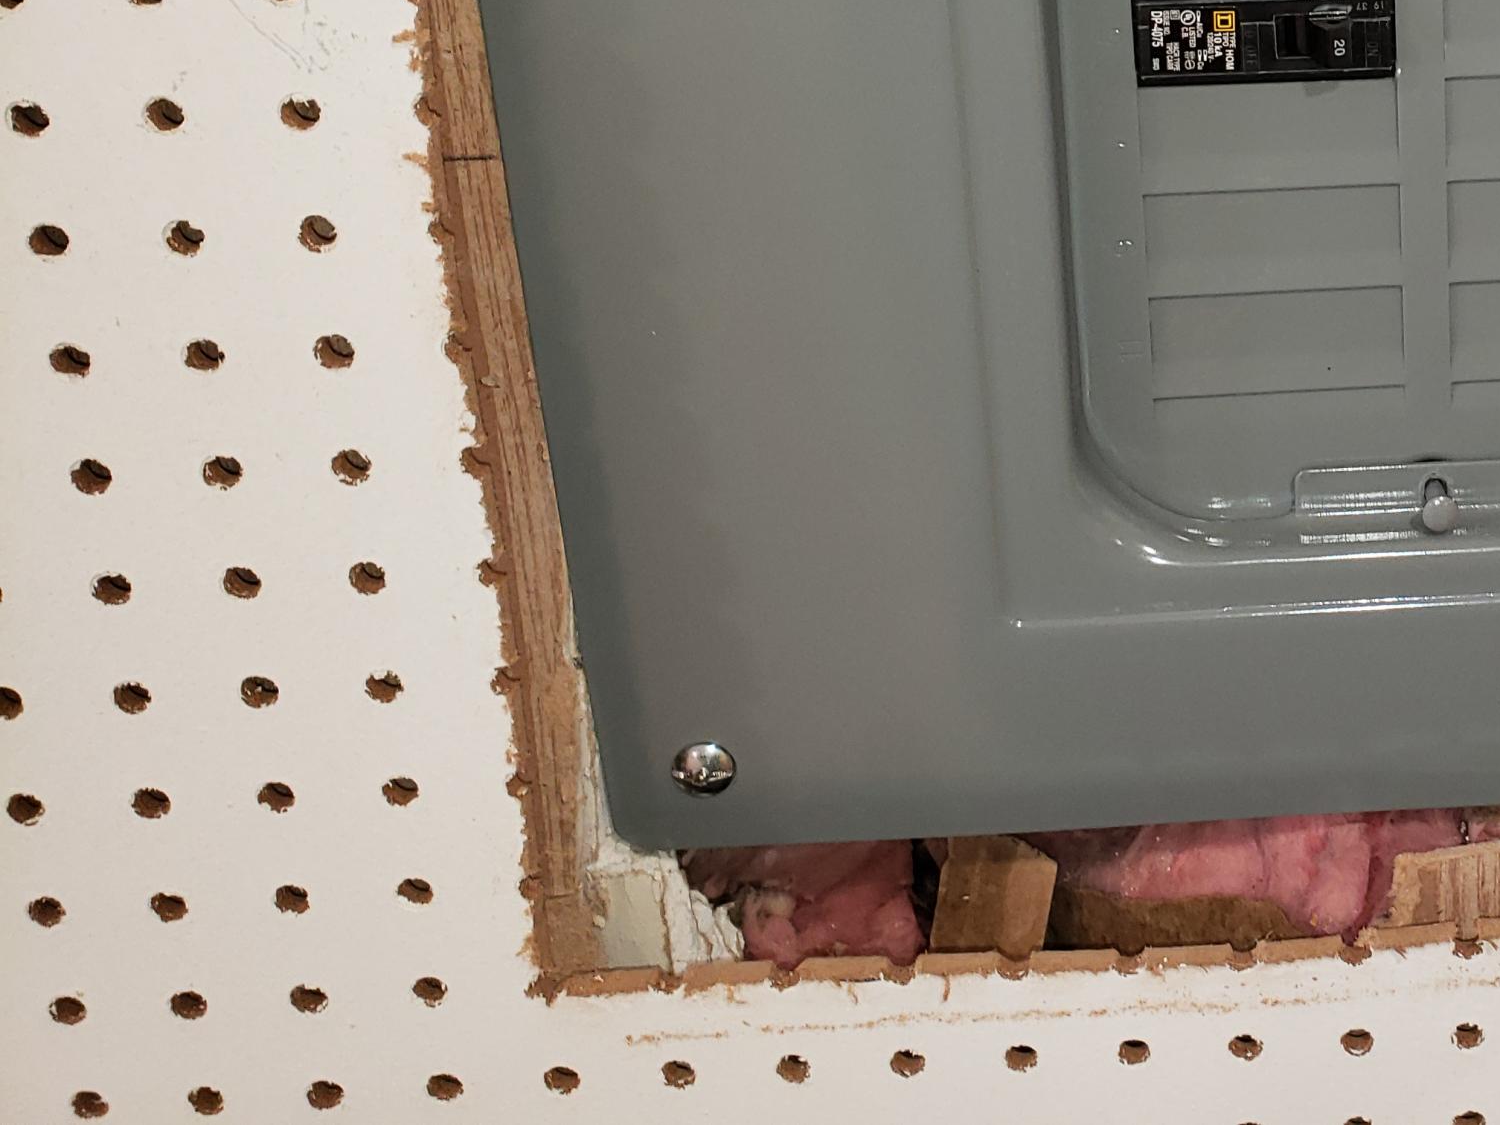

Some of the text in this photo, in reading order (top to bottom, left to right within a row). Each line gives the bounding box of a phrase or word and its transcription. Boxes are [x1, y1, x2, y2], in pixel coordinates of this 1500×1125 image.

[1151, 11, 1164, 47] DP-4075
[1214, 33, 1223, 57] 10 kA
[1334, 39, 1345, 56] 20
[1226, 49, 1234, 70] HOM
